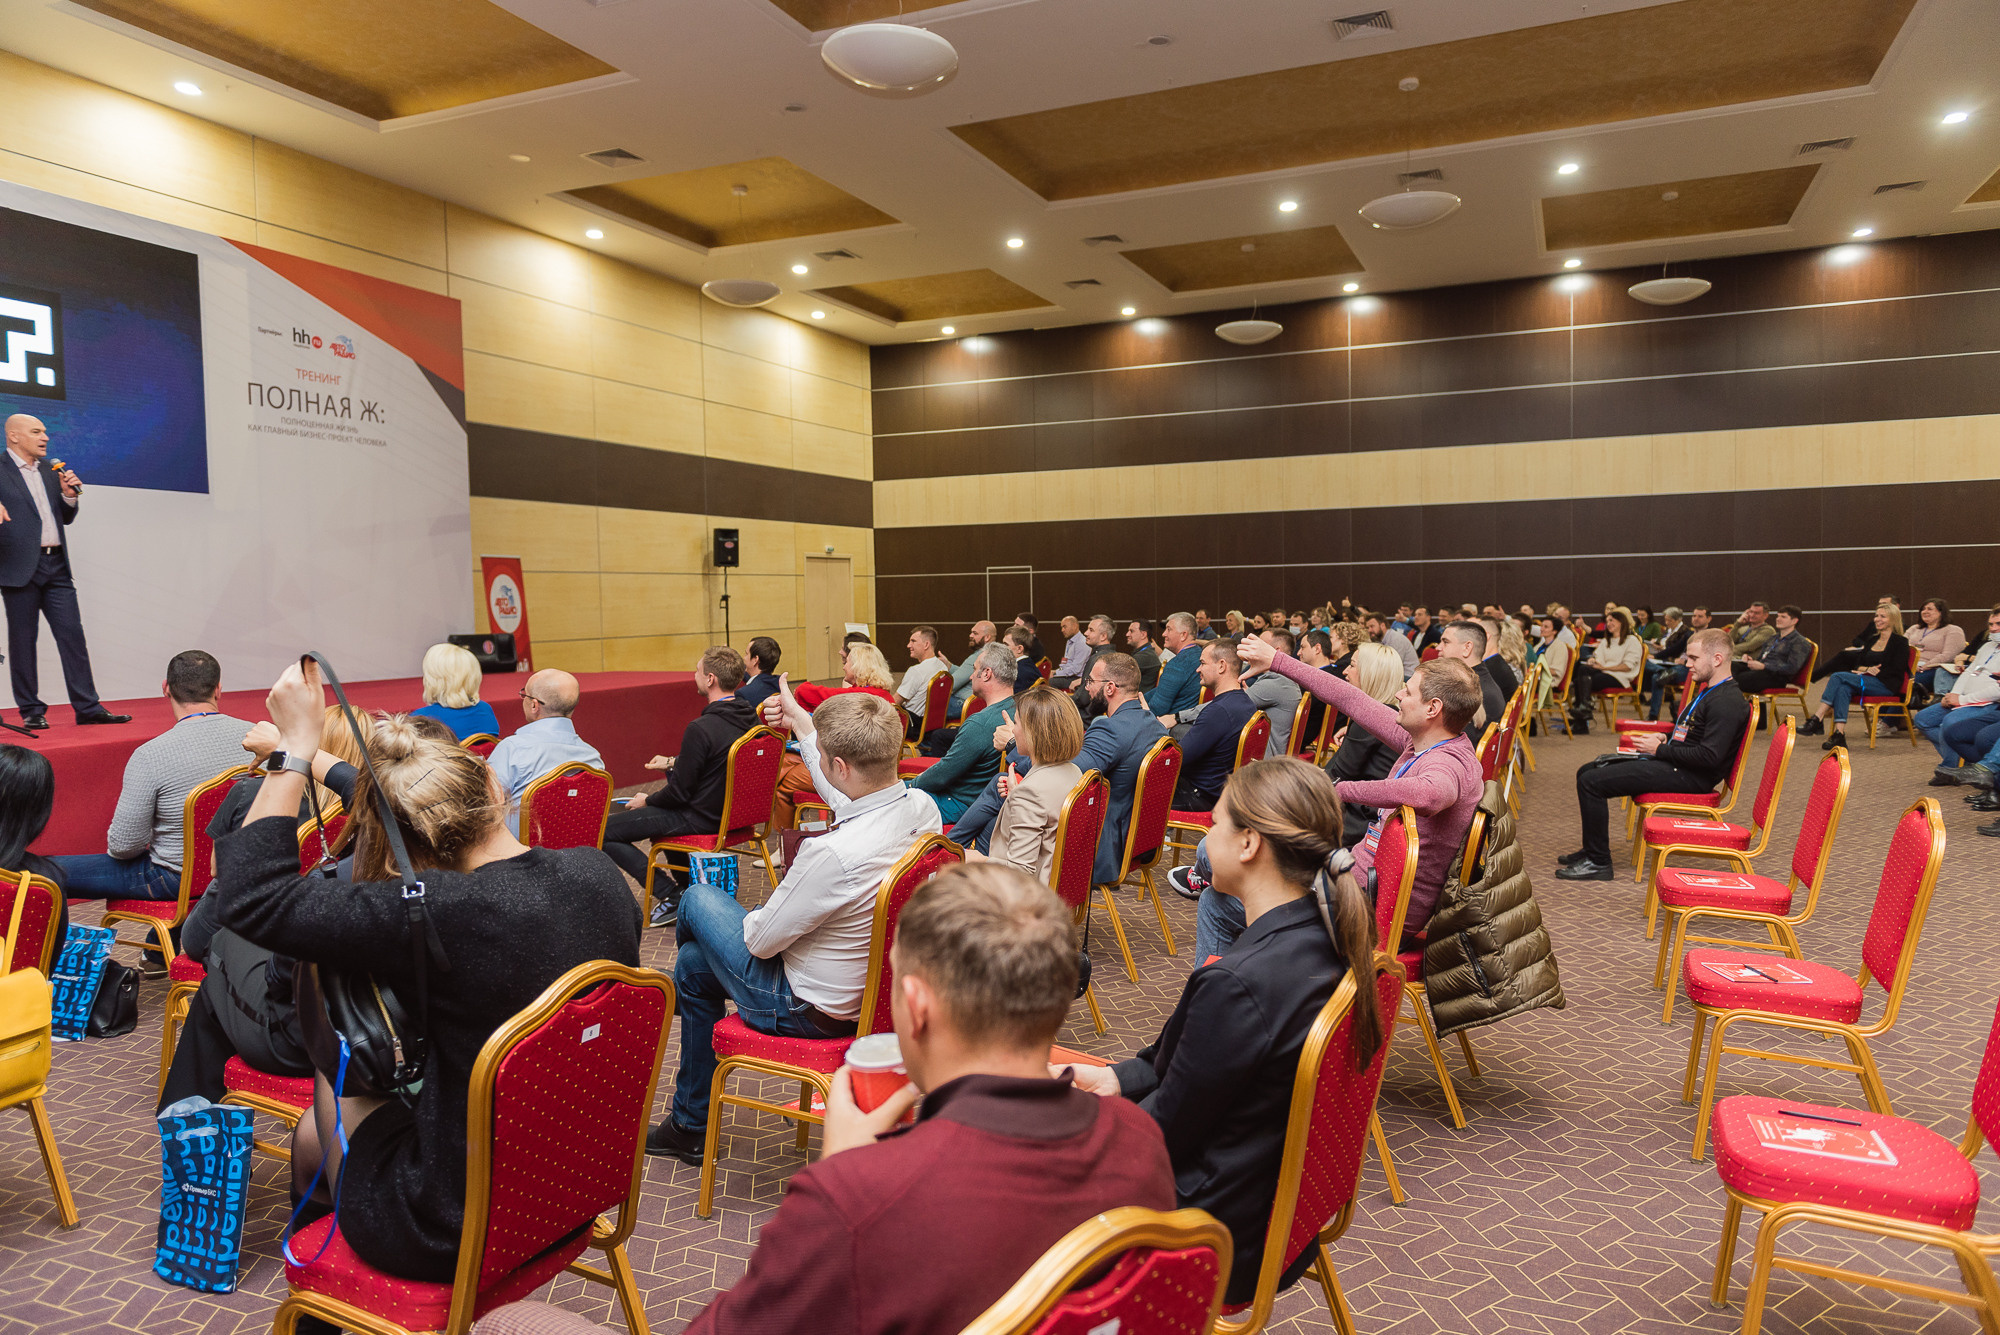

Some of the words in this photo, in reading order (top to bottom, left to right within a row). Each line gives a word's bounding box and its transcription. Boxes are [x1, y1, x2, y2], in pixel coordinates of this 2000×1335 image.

[296, 368, 342, 386] ТРЕНИНГ
[248, 382, 352, 419] ПОЛНАЯ
[359, 399, 385, 424] Ж:
[247, 423, 263, 433] КАК
[264, 424, 298, 436] ГЛАВНЫЙ
[354, 436, 388, 447] ЧЕЛОВЕКА
[280, 416, 334, 430] ПОЛНОЦЕННАЯ
[335, 424, 359, 434] ЖИЗНЬ
